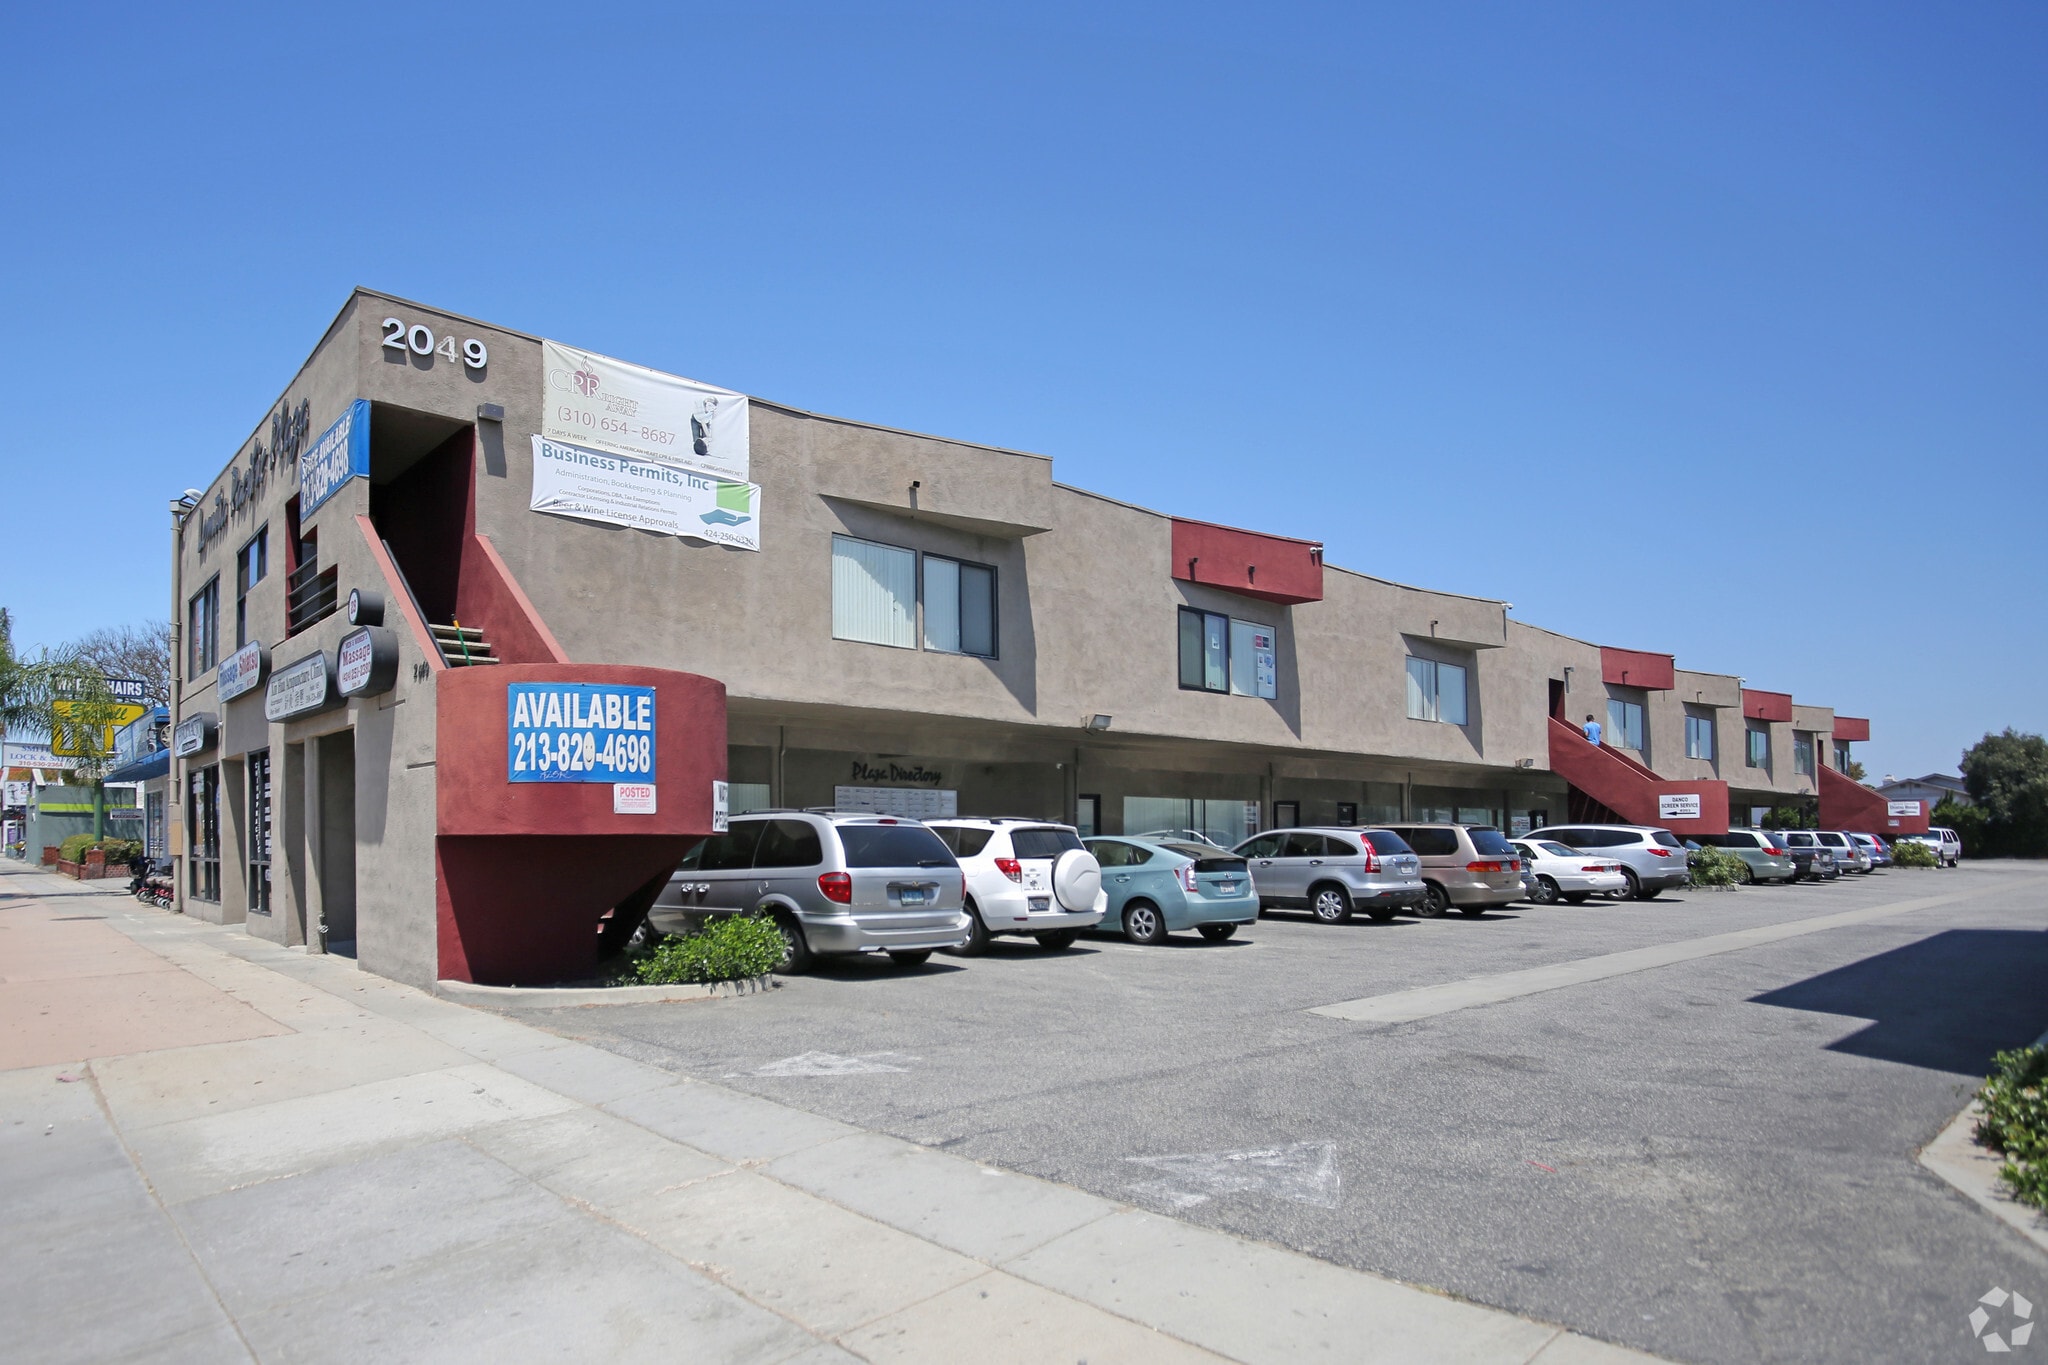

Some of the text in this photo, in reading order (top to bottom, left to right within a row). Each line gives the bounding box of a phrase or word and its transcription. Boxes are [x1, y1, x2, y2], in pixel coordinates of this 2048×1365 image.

[382, 317, 487, 369] 2049
[549, 369, 601, 400] CPR
[602, 393, 638, 409] RIGHT
[605, 404, 638, 417] AWAY
[319, 414, 350, 462] AVAILABLE
[552, 429, 567, 438] DAYS
[572, 432, 587, 441] WEEK
[558, 406, 596, 429] (310)
[600, 417, 628, 435] 654
[641, 426, 676, 445] 8687
[596, 440, 618, 448] OFFERING
[542, 444, 709, 490] Business Permits, Inc
[555, 468, 610, 486] Administration,
[612, 479, 655, 495] Bookkeeping
[664, 490, 692, 502] Planning
[575, 503, 581, 511] &
[583, 505, 605, 515] Wine
[606, 509, 637, 521] License
[639, 515, 678, 529] Approvals
[342, 644, 370, 666] Massage
[513, 693, 651, 730] AVAILABLE
[514, 732, 650, 773] 213-820-4698
[852, 761, 942, 786] Plaza Directory
[620, 787, 650, 798] POSTED
